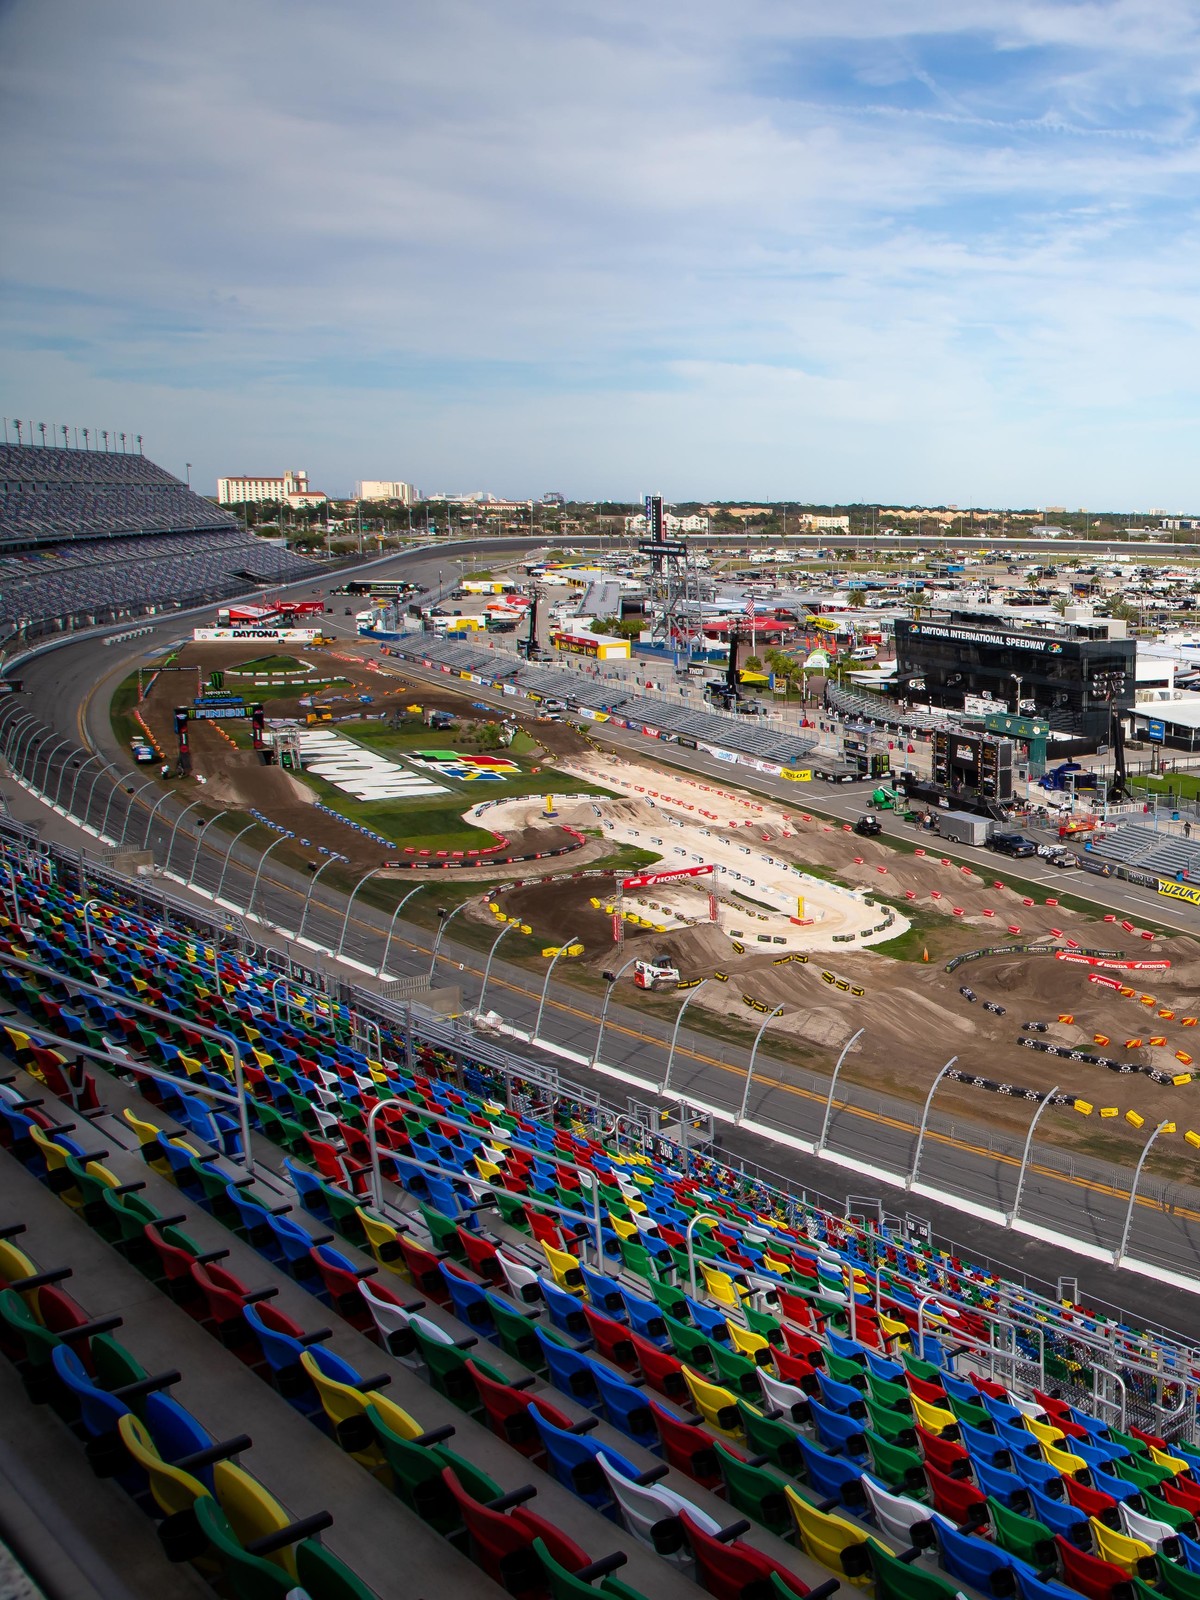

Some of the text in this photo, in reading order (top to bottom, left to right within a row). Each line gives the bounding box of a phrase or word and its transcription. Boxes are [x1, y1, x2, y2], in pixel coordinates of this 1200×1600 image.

[232, 630, 279, 638] DAYTONA
[921, 626, 1045, 650] DAYTONA INTERNATIONAL SPEEDWAY
[196, 708, 245, 718] FINISH
[656, 872, 692, 884] HONDA
[1065, 956, 1090, 964] HONDA
[1096, 978, 1116, 989] HONDA
[660, 1142, 673, 1159] 366
